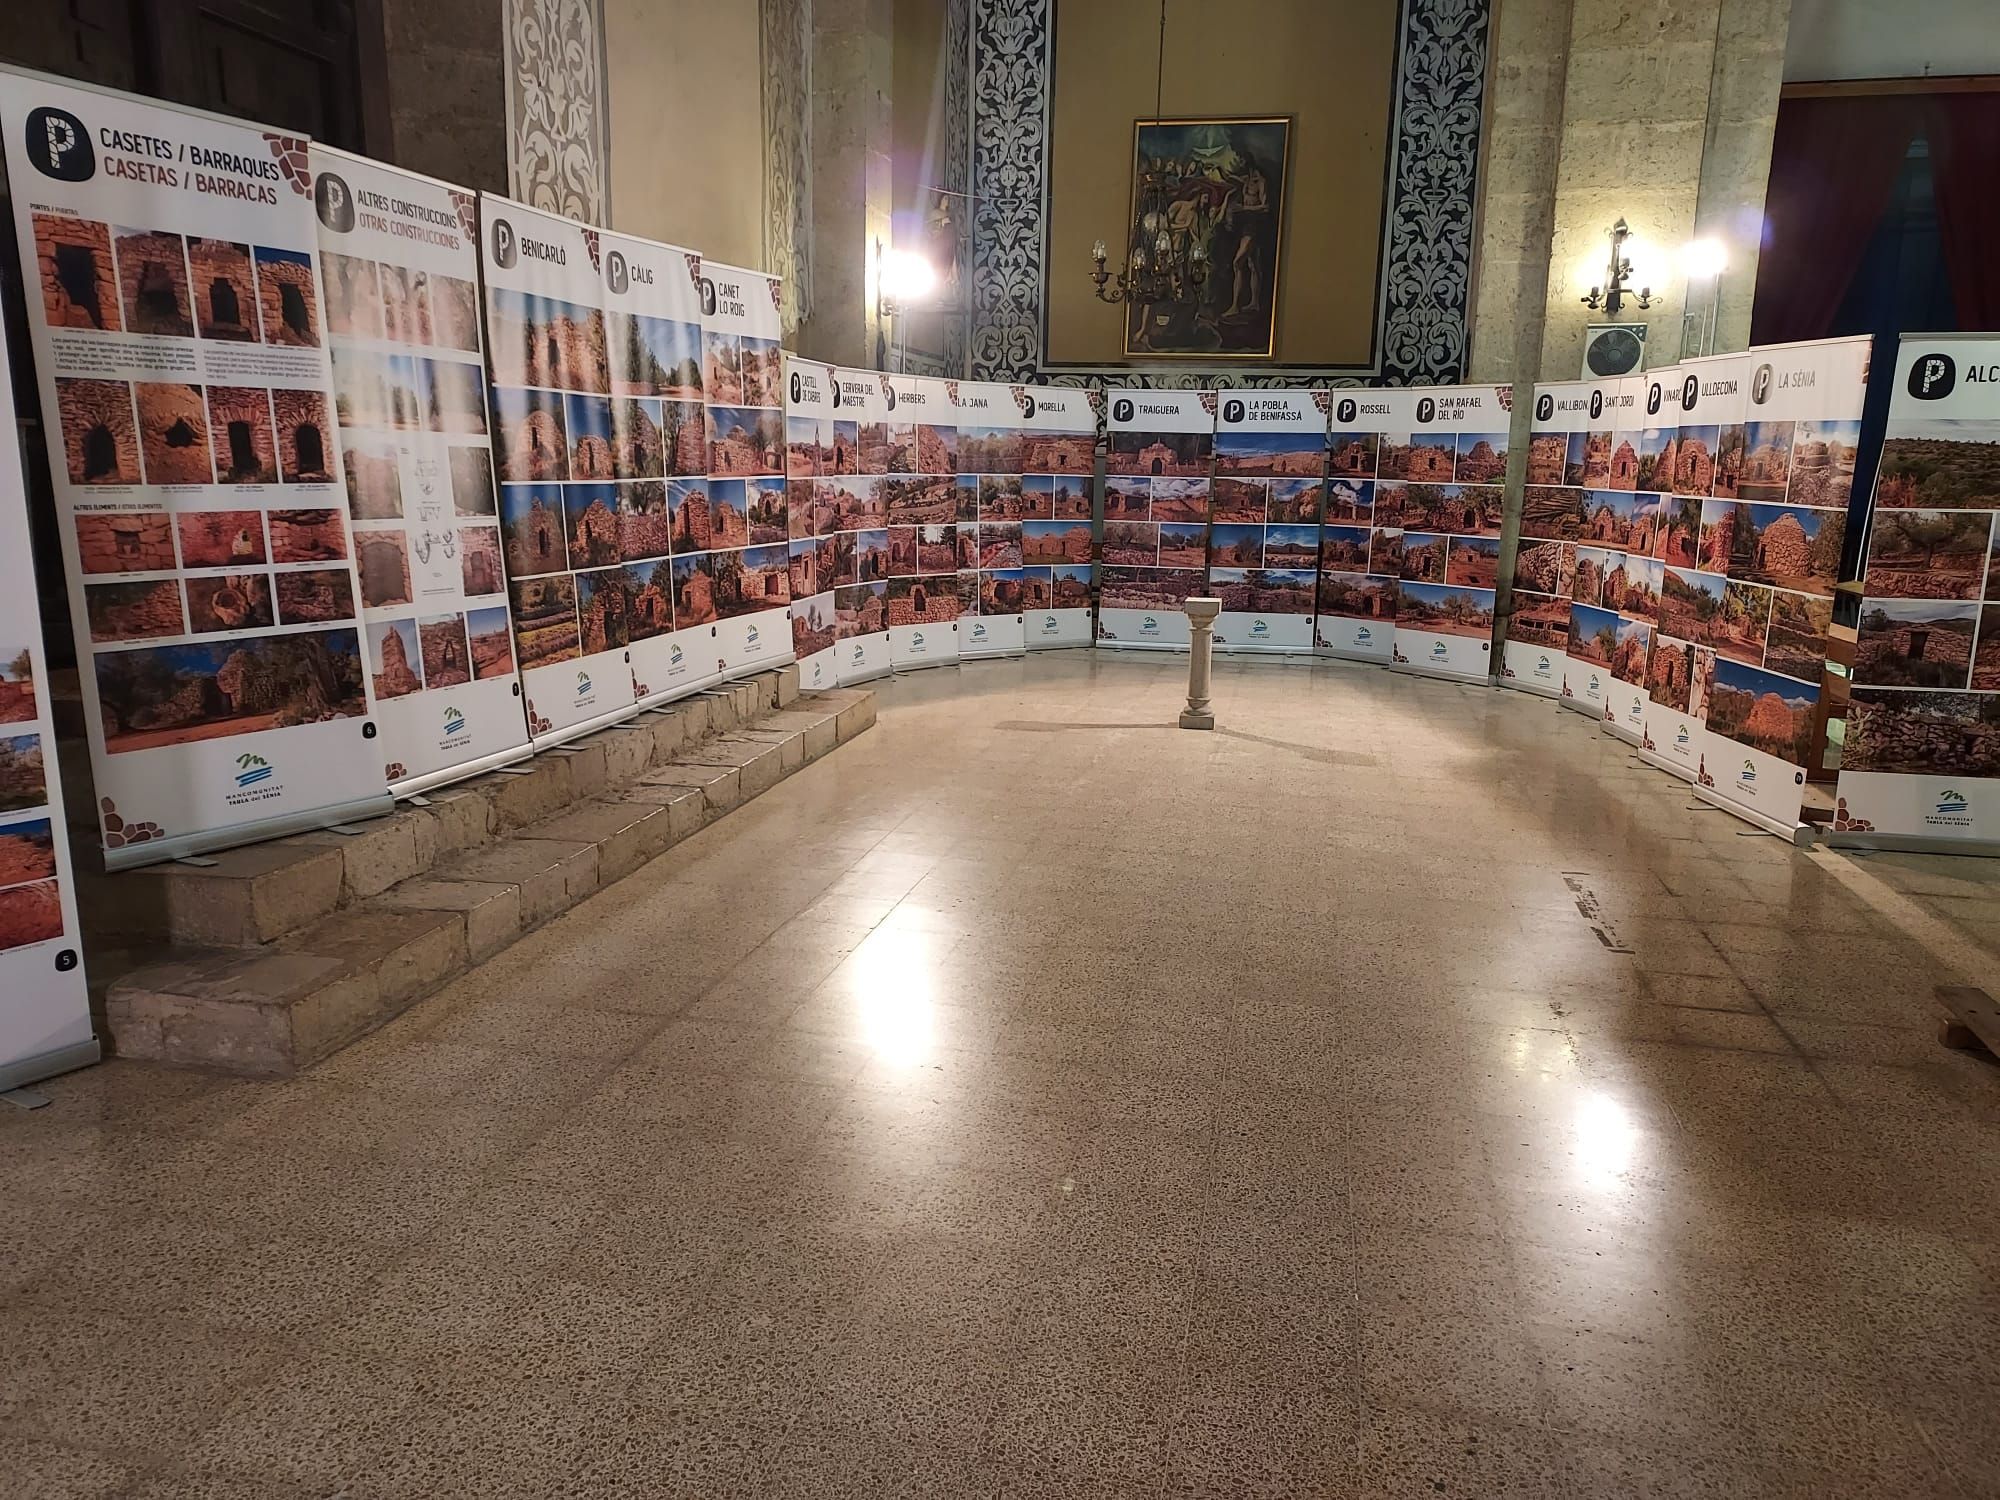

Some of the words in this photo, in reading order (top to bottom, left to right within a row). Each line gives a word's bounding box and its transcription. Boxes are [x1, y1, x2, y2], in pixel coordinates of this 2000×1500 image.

[100, 127, 173, 160] CASETES
[191, 146, 280, 181] BARRAQUES
[104, 156, 178, 187] CASETAS
[196, 173, 278, 205] BARRACAS
[357, 189, 389, 212] ALTRES
[391, 200, 457, 230] CONSTRUCCIONS
[359, 212, 388, 233] OTRAS
[390, 222, 460, 250] CONSTRUCCIONES
[521, 237, 566, 266] BENICARLÓ
[718, 282, 740, 300] CANET
[719, 301, 728, 316] LO
[730, 302, 745, 318] ROIG
[1778, 372, 1789, 389] LA
[1965, 365, 2000, 383] ALC
[802, 375, 817, 389] CASTELL
[843, 382, 864, 395] CERVERA
[865, 384, 874, 396] DEL
[1702, 380, 1738, 397] ULLDECONA
[842, 395, 865, 408] MAESTRE
[898, 391, 926, 405] HERBERS
[957, 398, 967, 408] LA
[969, 398, 988, 409] JANA
[1249, 401, 1259, 410] LA
[1262, 400, 1288, 410] POBLA
[1439, 398, 1454, 409] SAN
[1456, 397, 1482, 409] RAFAEL
[1557, 399, 1589, 411] VALLIBON
[1604, 396, 1619, 408] SANT
[1619, 395, 1635, 408] JORDI
[1038, 401, 1066, 412] MORELLA
[1138, 404, 1180, 415] TRAIGUERA
[1360, 404, 1391, 414] ROSSELL
[1249, 411, 1258, 421] DE
[1438, 410, 1450, 420] DEL
[1452, 409, 1464, 420] RÍO
[225, 784, 283, 800] MANCOMUNITAT
